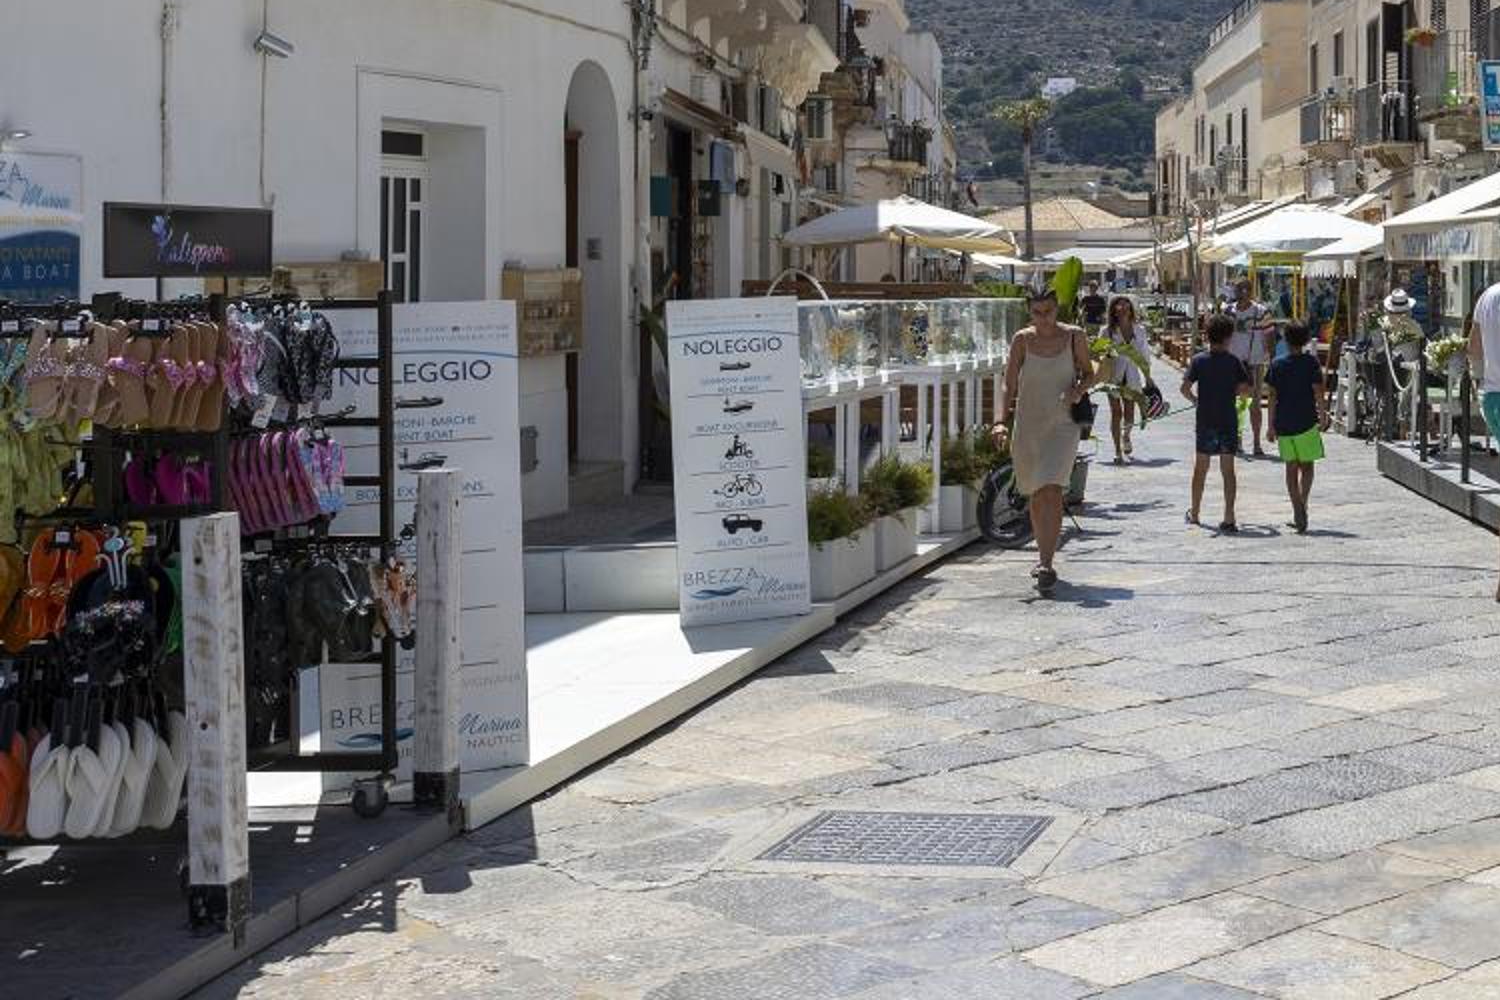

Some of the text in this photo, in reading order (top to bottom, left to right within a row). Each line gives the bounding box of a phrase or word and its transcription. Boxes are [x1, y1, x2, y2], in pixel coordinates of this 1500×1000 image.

[23, 263, 71, 280] BOAT
[683, 336, 782, 356] NOLEGGIO
[339, 359, 492, 387] NOEGGIO
[424, 429, 455, 441] BOAT
[683, 567, 757, 588] BREZZA
[458, 712, 522, 735] Marina
